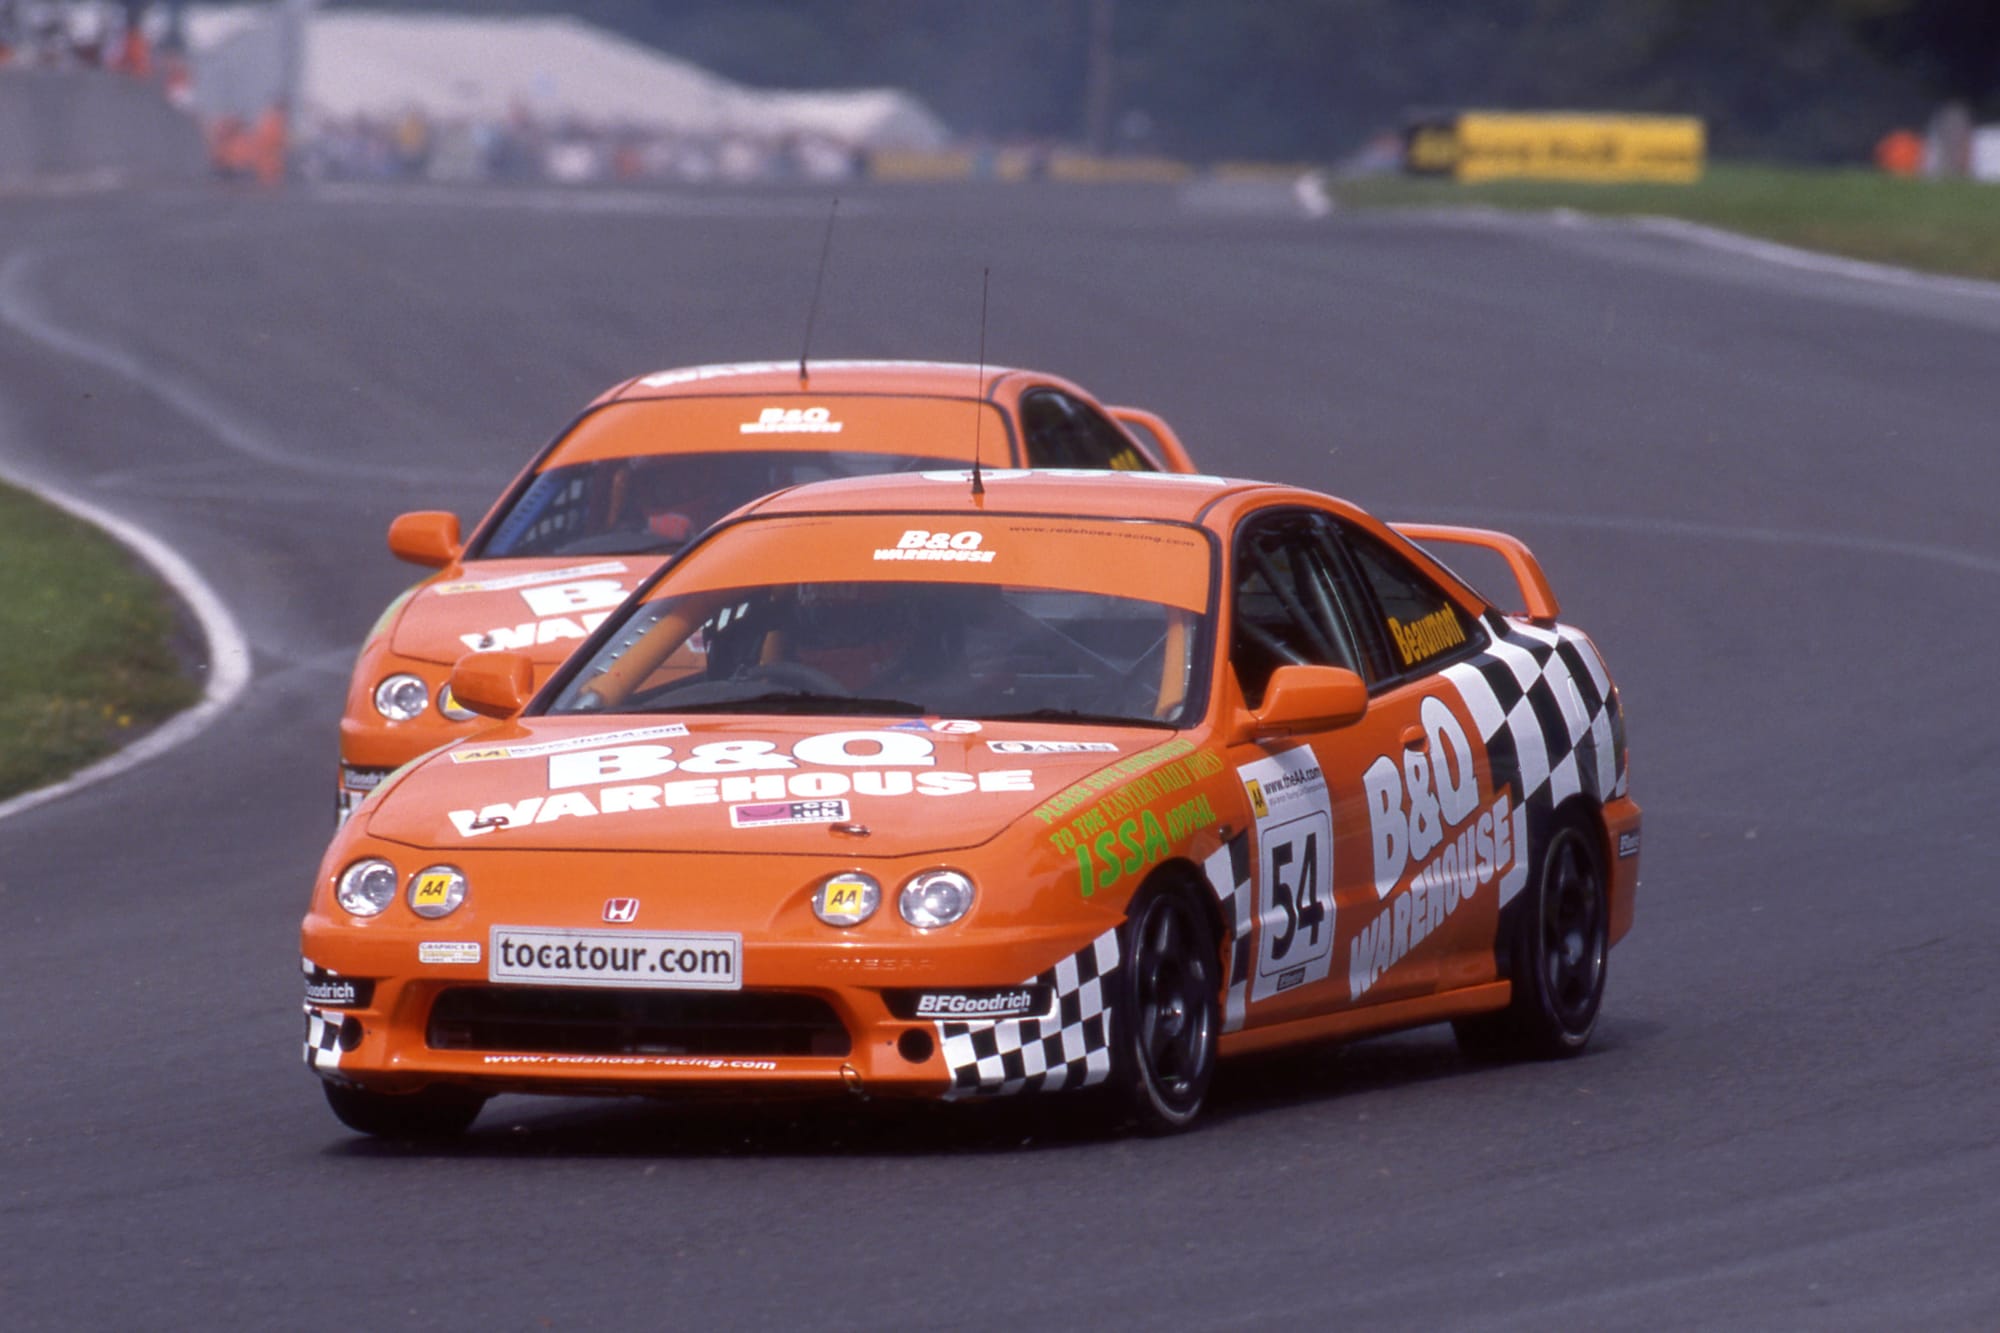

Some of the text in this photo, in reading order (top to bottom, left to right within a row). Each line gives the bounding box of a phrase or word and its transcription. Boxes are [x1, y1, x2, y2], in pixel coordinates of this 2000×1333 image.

[758, 407, 830, 423] B&Q
[873, 548, 997, 564] WAREHOUSE
[896, 530, 983, 549] B&Q
[1388, 602, 1466, 666] Beaumont
[548, 731, 936, 789] B&Q
[448, 769, 1034, 838] WAREHOUSE
[1033, 784, 1094, 824] PLEASE
[1363, 695, 1479, 900] B&Q
[1049, 828, 1076, 854] TO
[1072, 807, 1107, 839] THE
[1075, 793, 1217, 897] ISSA APPEAL
[419, 880, 446, 896] AA
[830, 890, 858, 906] AA
[1271, 832, 1325, 960] 54
[1348, 794, 1513, 1000] WAREHOUSE
[500, 938, 732, 974] tocatour.com
[916, 991, 1032, 1013] BFGoodrich
[483, 1056, 776, 1071] www.redshoes-racing.com
